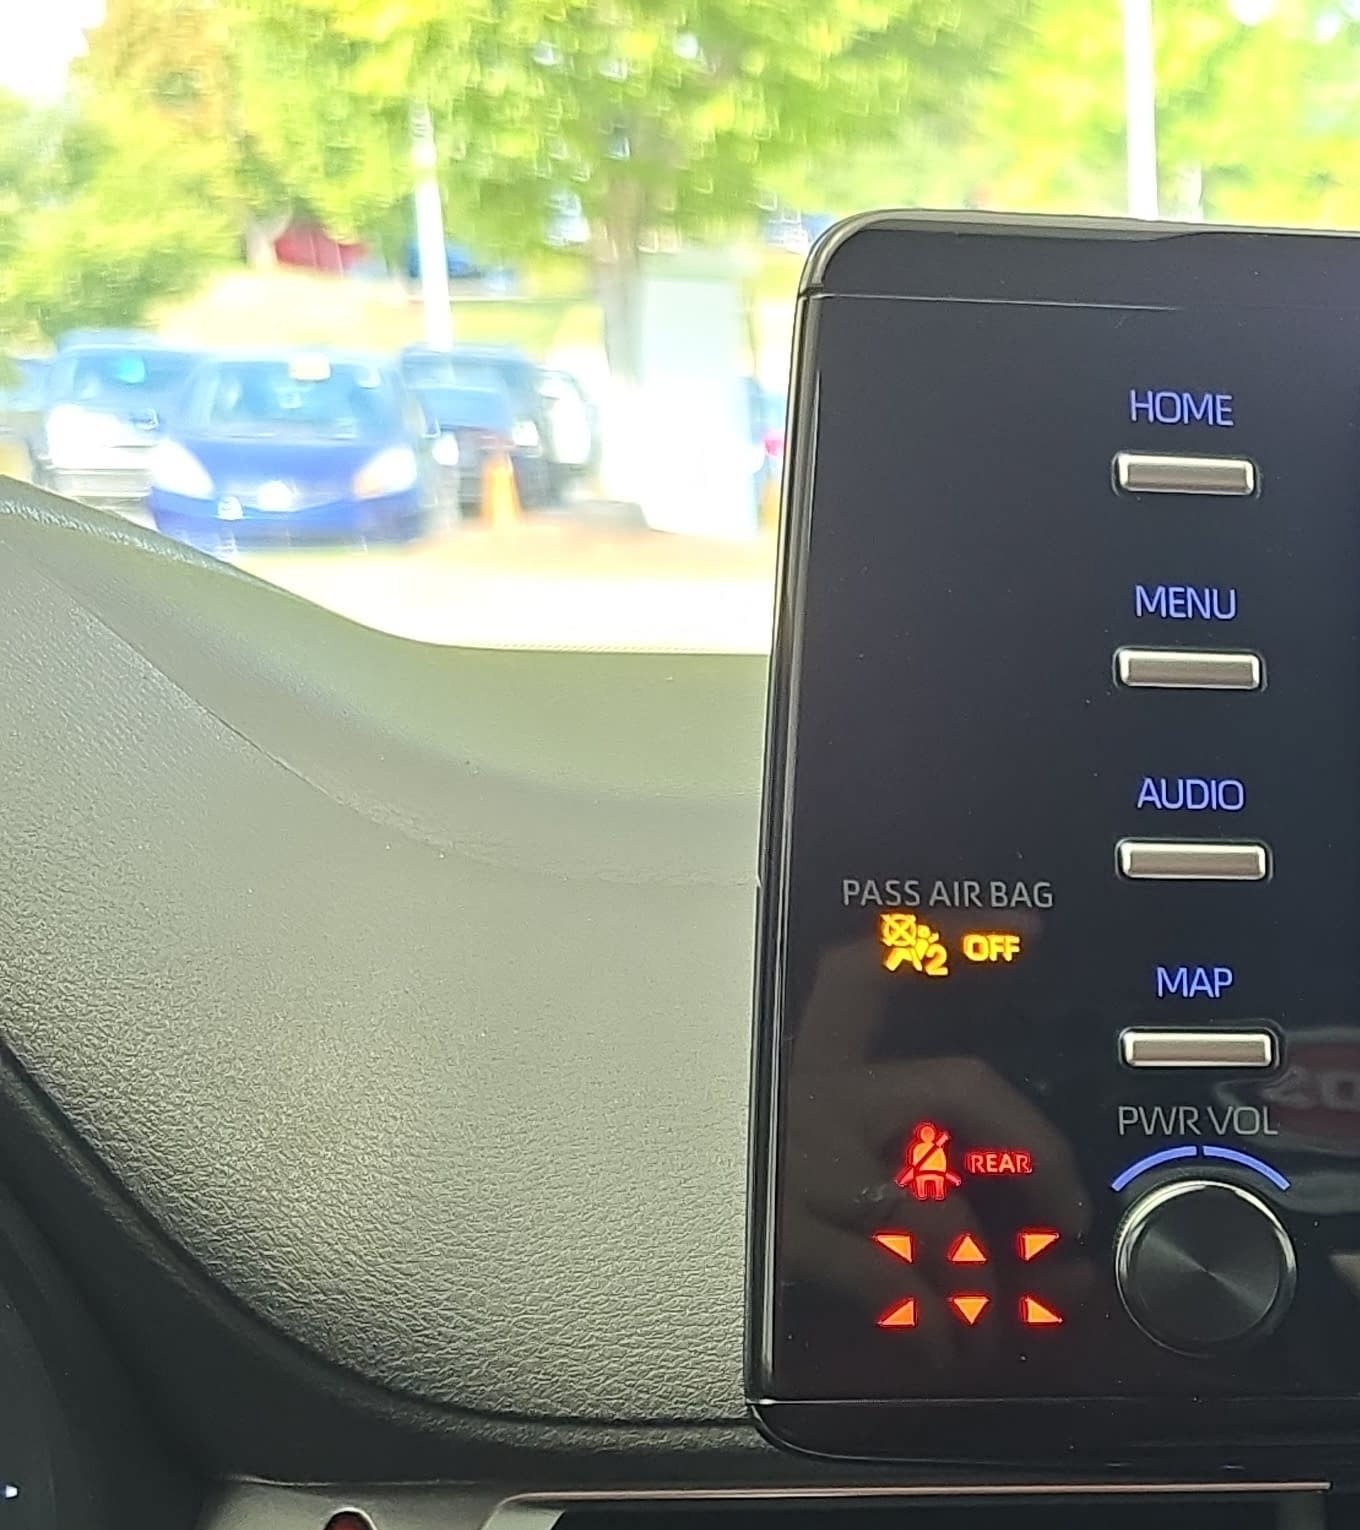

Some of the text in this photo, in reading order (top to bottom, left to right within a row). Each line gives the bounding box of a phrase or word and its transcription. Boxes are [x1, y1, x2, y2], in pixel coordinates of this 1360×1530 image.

[1129, 389, 1234, 428] HOME
[1135, 586, 1237, 620] MENU
[1137, 778, 1245, 810] AUDIO
[843, 880, 1053, 909] PASS AIR BAG
[964, 934, 1020, 961] OFF
[1156, 967, 1233, 999] MAP
[1119, 1106, 1278, 1136] PWR VOL
[968, 1152, 1033, 1175] REAR
